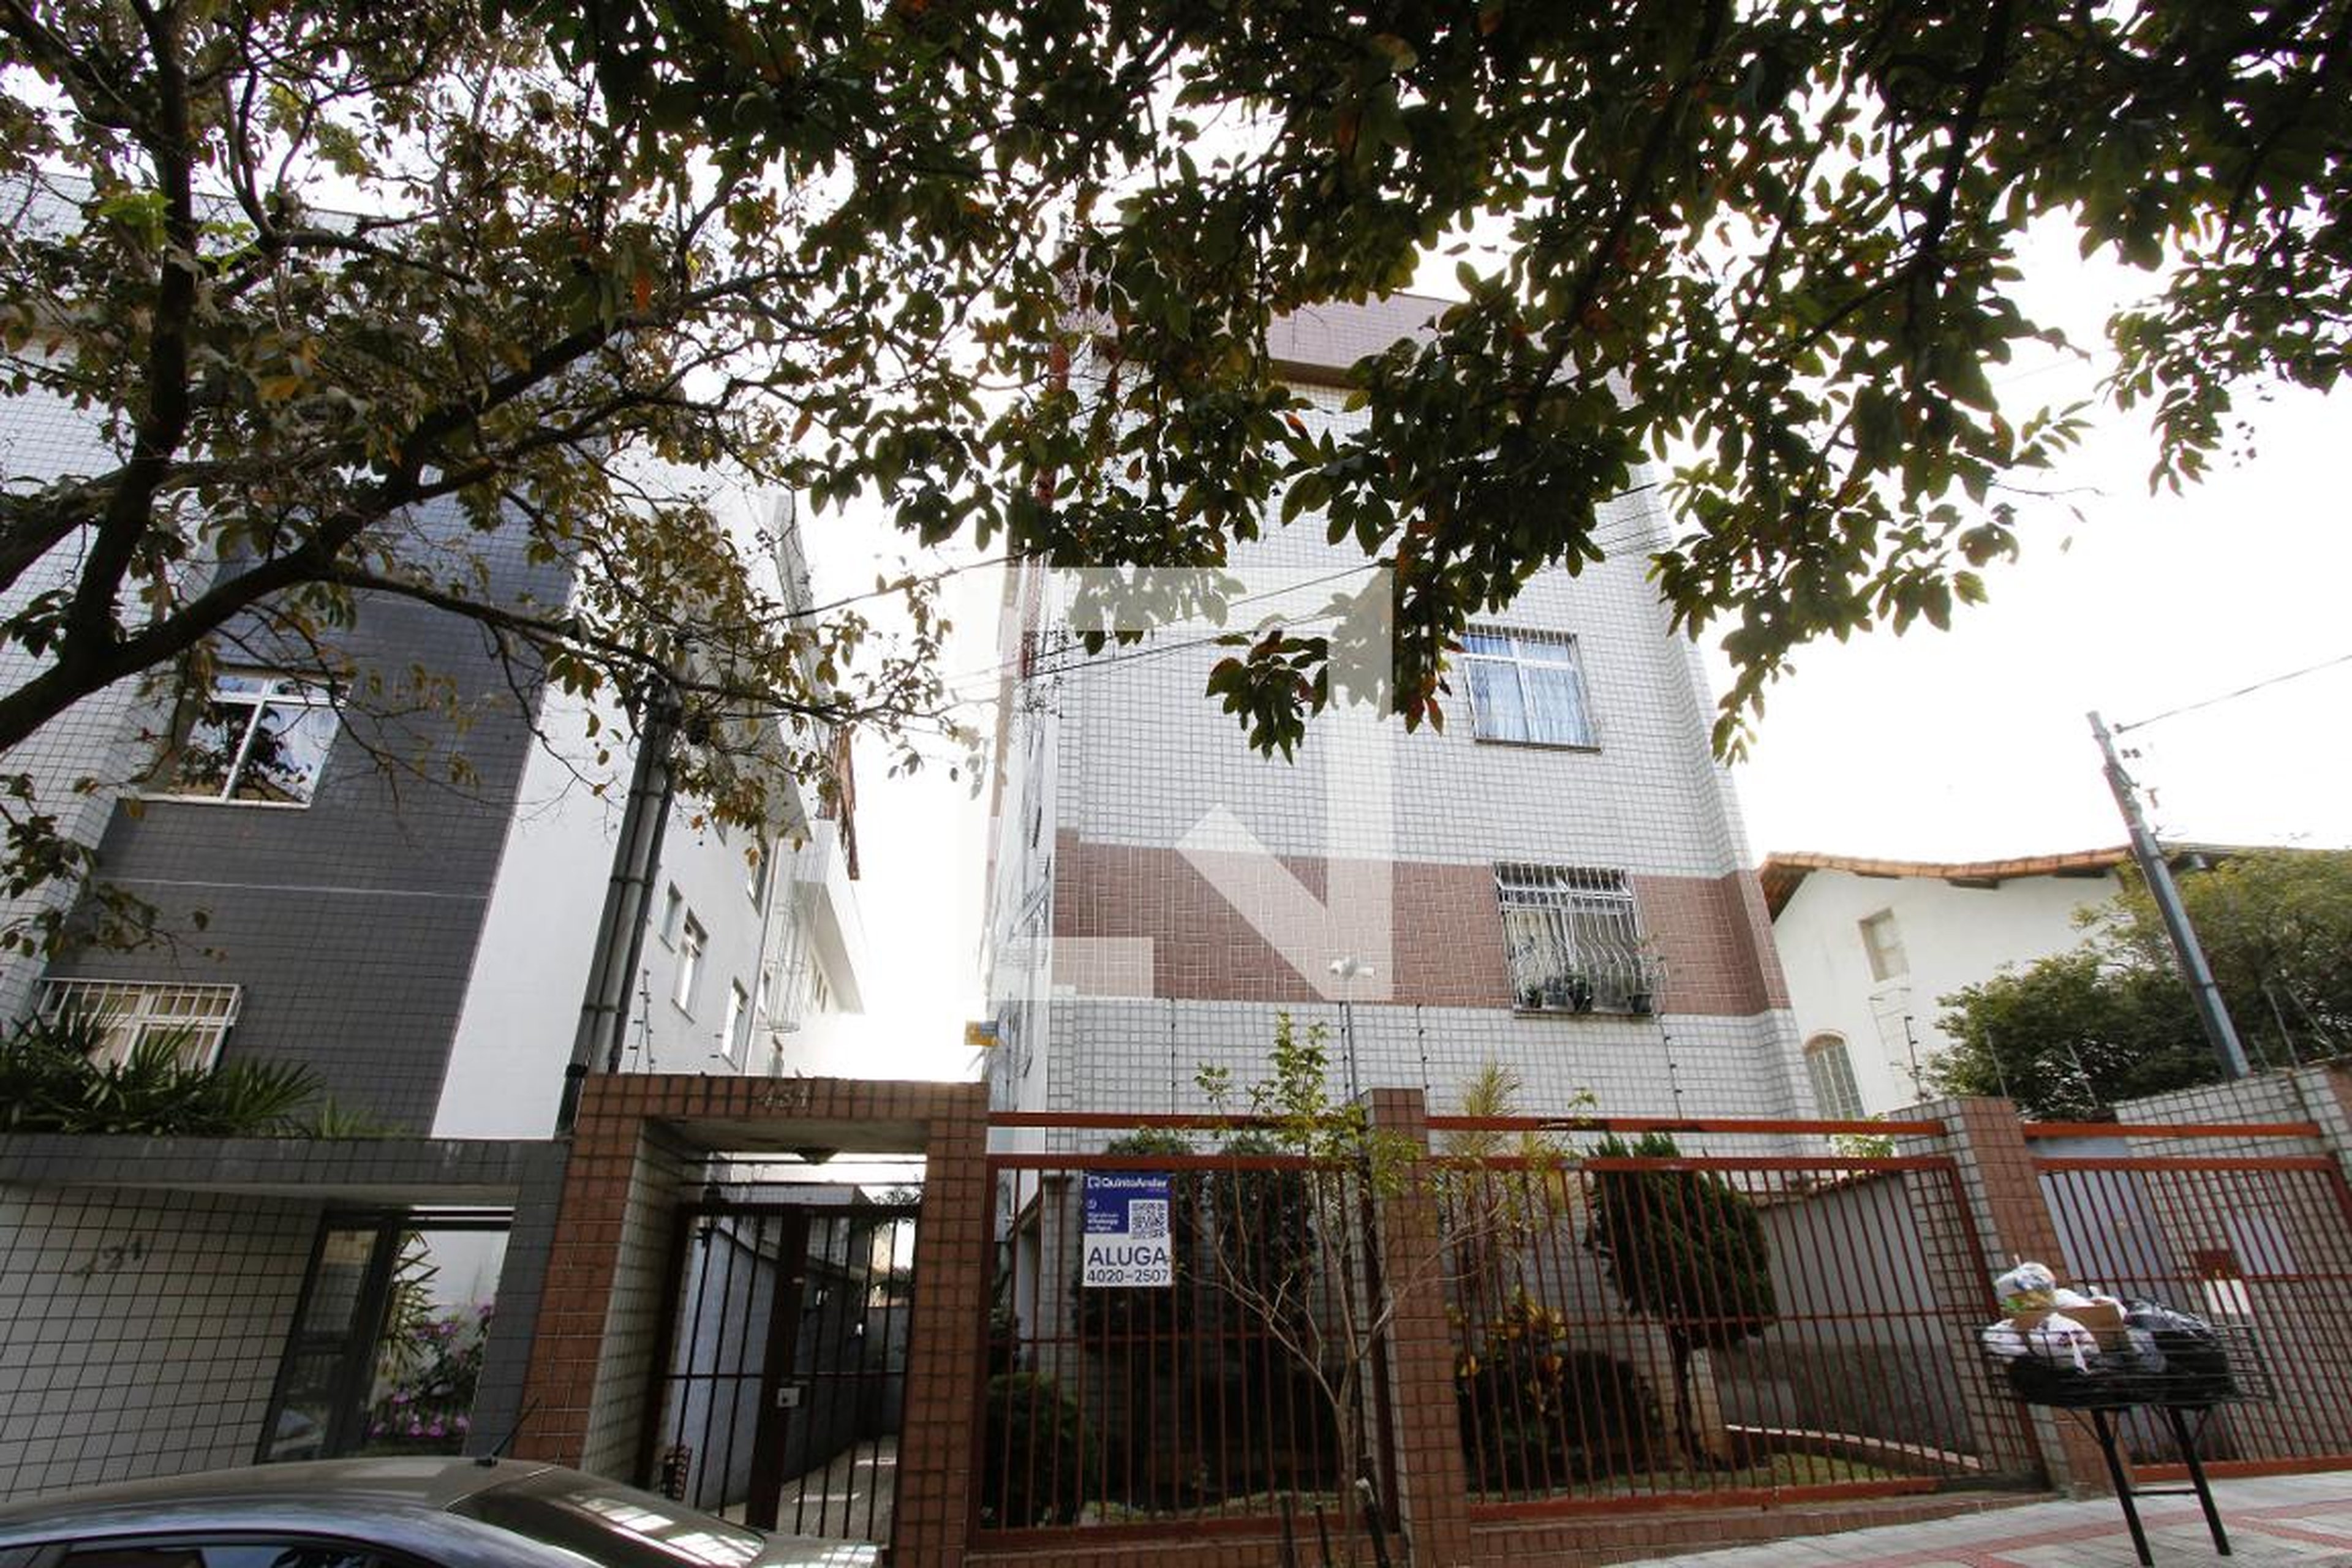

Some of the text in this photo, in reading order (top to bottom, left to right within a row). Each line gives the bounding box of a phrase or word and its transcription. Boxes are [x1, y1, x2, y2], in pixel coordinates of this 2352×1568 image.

[1102, 1177, 1167, 1188] QuintoAndar
[1088, 1246, 1167, 1266] ALUGA
[1087, 1268, 1168, 1283] 4020-2507
